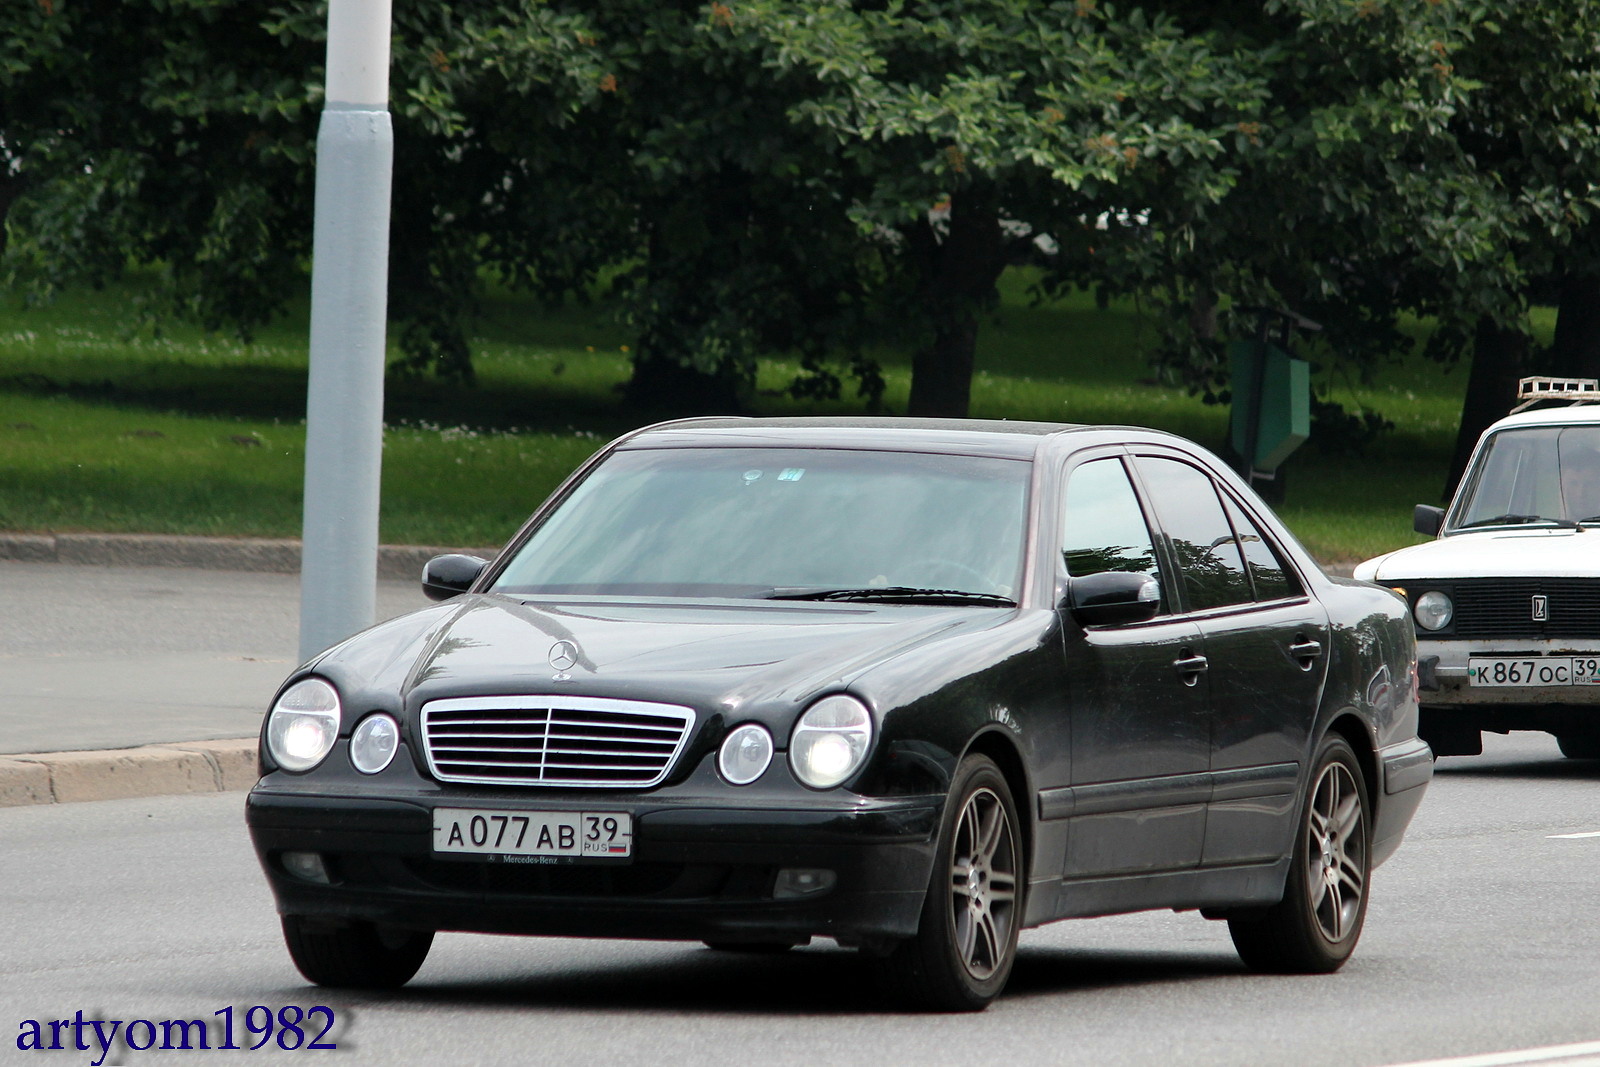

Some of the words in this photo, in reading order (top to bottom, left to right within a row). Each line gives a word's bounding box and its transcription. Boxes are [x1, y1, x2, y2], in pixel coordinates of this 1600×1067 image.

[1575, 659, 1597, 676] 39
[586, 816, 618, 841] 39
[584, 841, 608, 852] RUS
[502, 855, 559, 864] Mercedes-Benz
